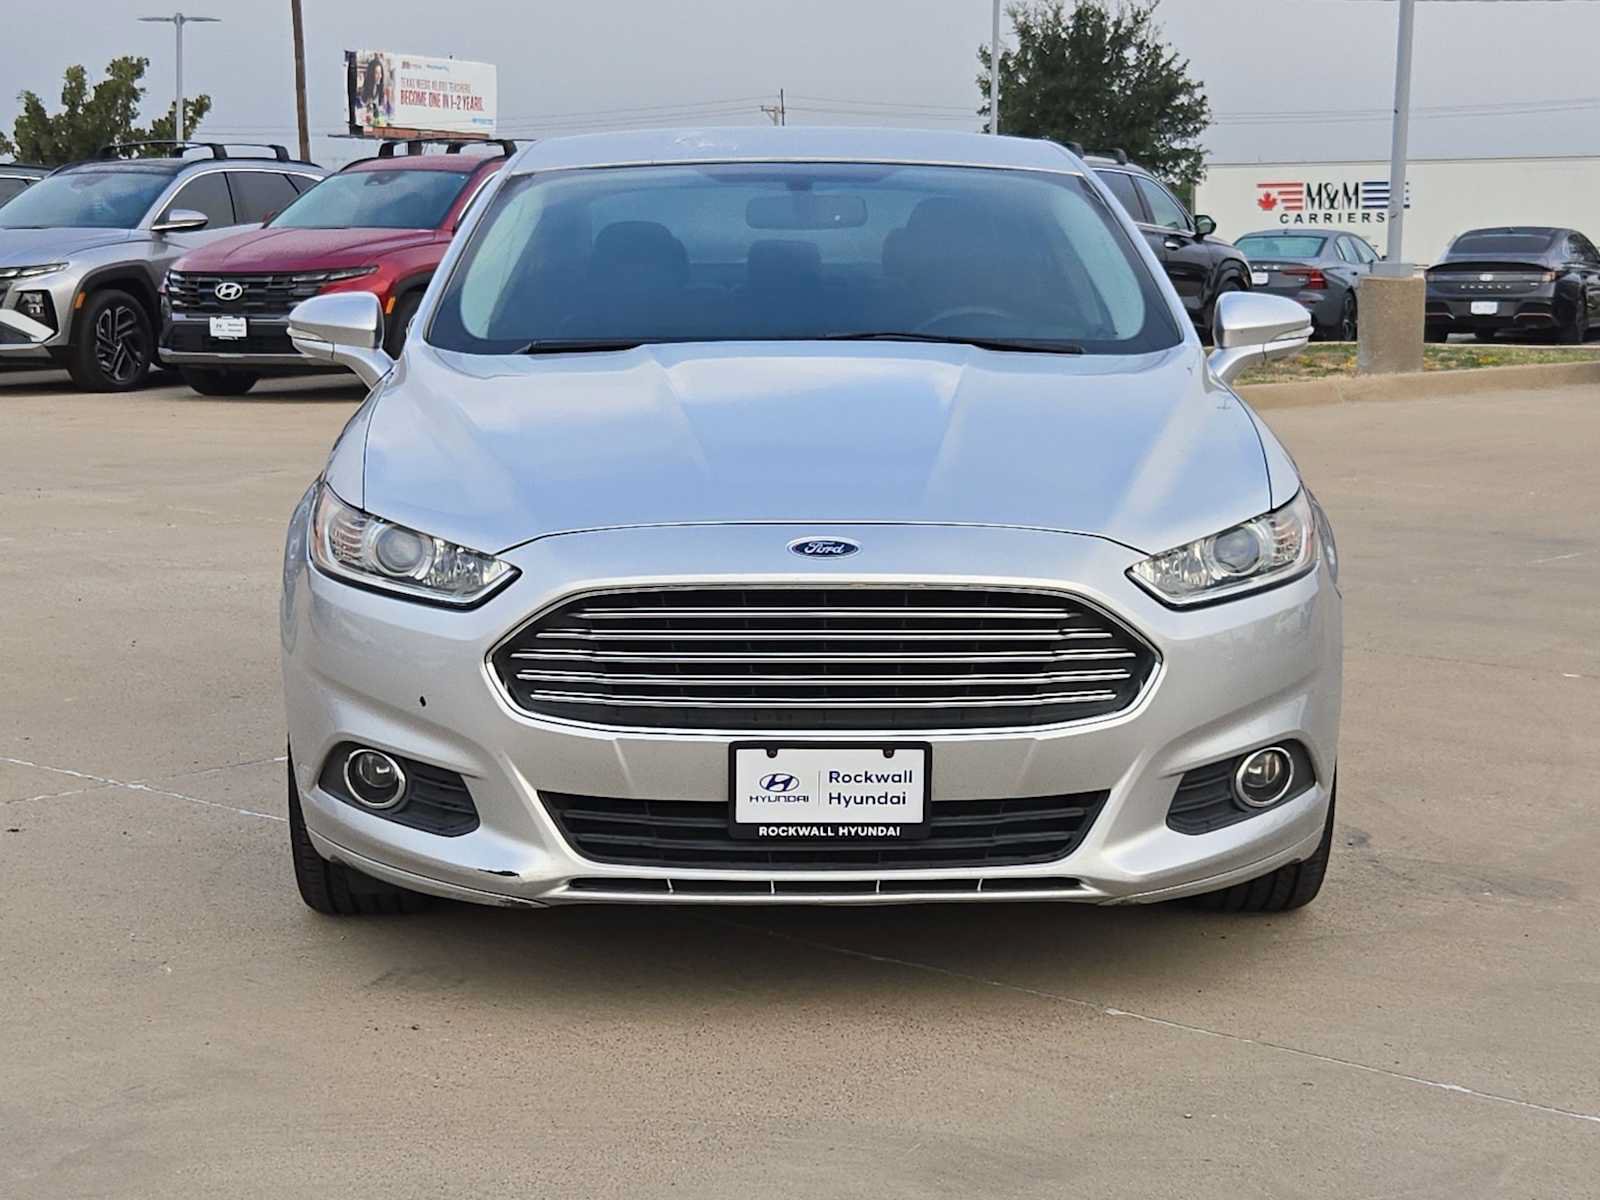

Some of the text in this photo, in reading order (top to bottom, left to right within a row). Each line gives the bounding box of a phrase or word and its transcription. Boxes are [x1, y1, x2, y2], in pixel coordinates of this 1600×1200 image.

[400, 90, 427, 106] BECOME
[428, 92, 441, 108] ONE
[1306, 182, 1359, 210] M&M
[1280, 212, 1385, 224] CARRIERS
[804, 542, 845, 554] Ford
[828, 770, 913, 784] Rockwall
[749, 795, 809, 803] HYUNDAI
[828, 792, 906, 808] Hyundai
[759, 826, 900, 836] ROCKWALL HYUNDAI
